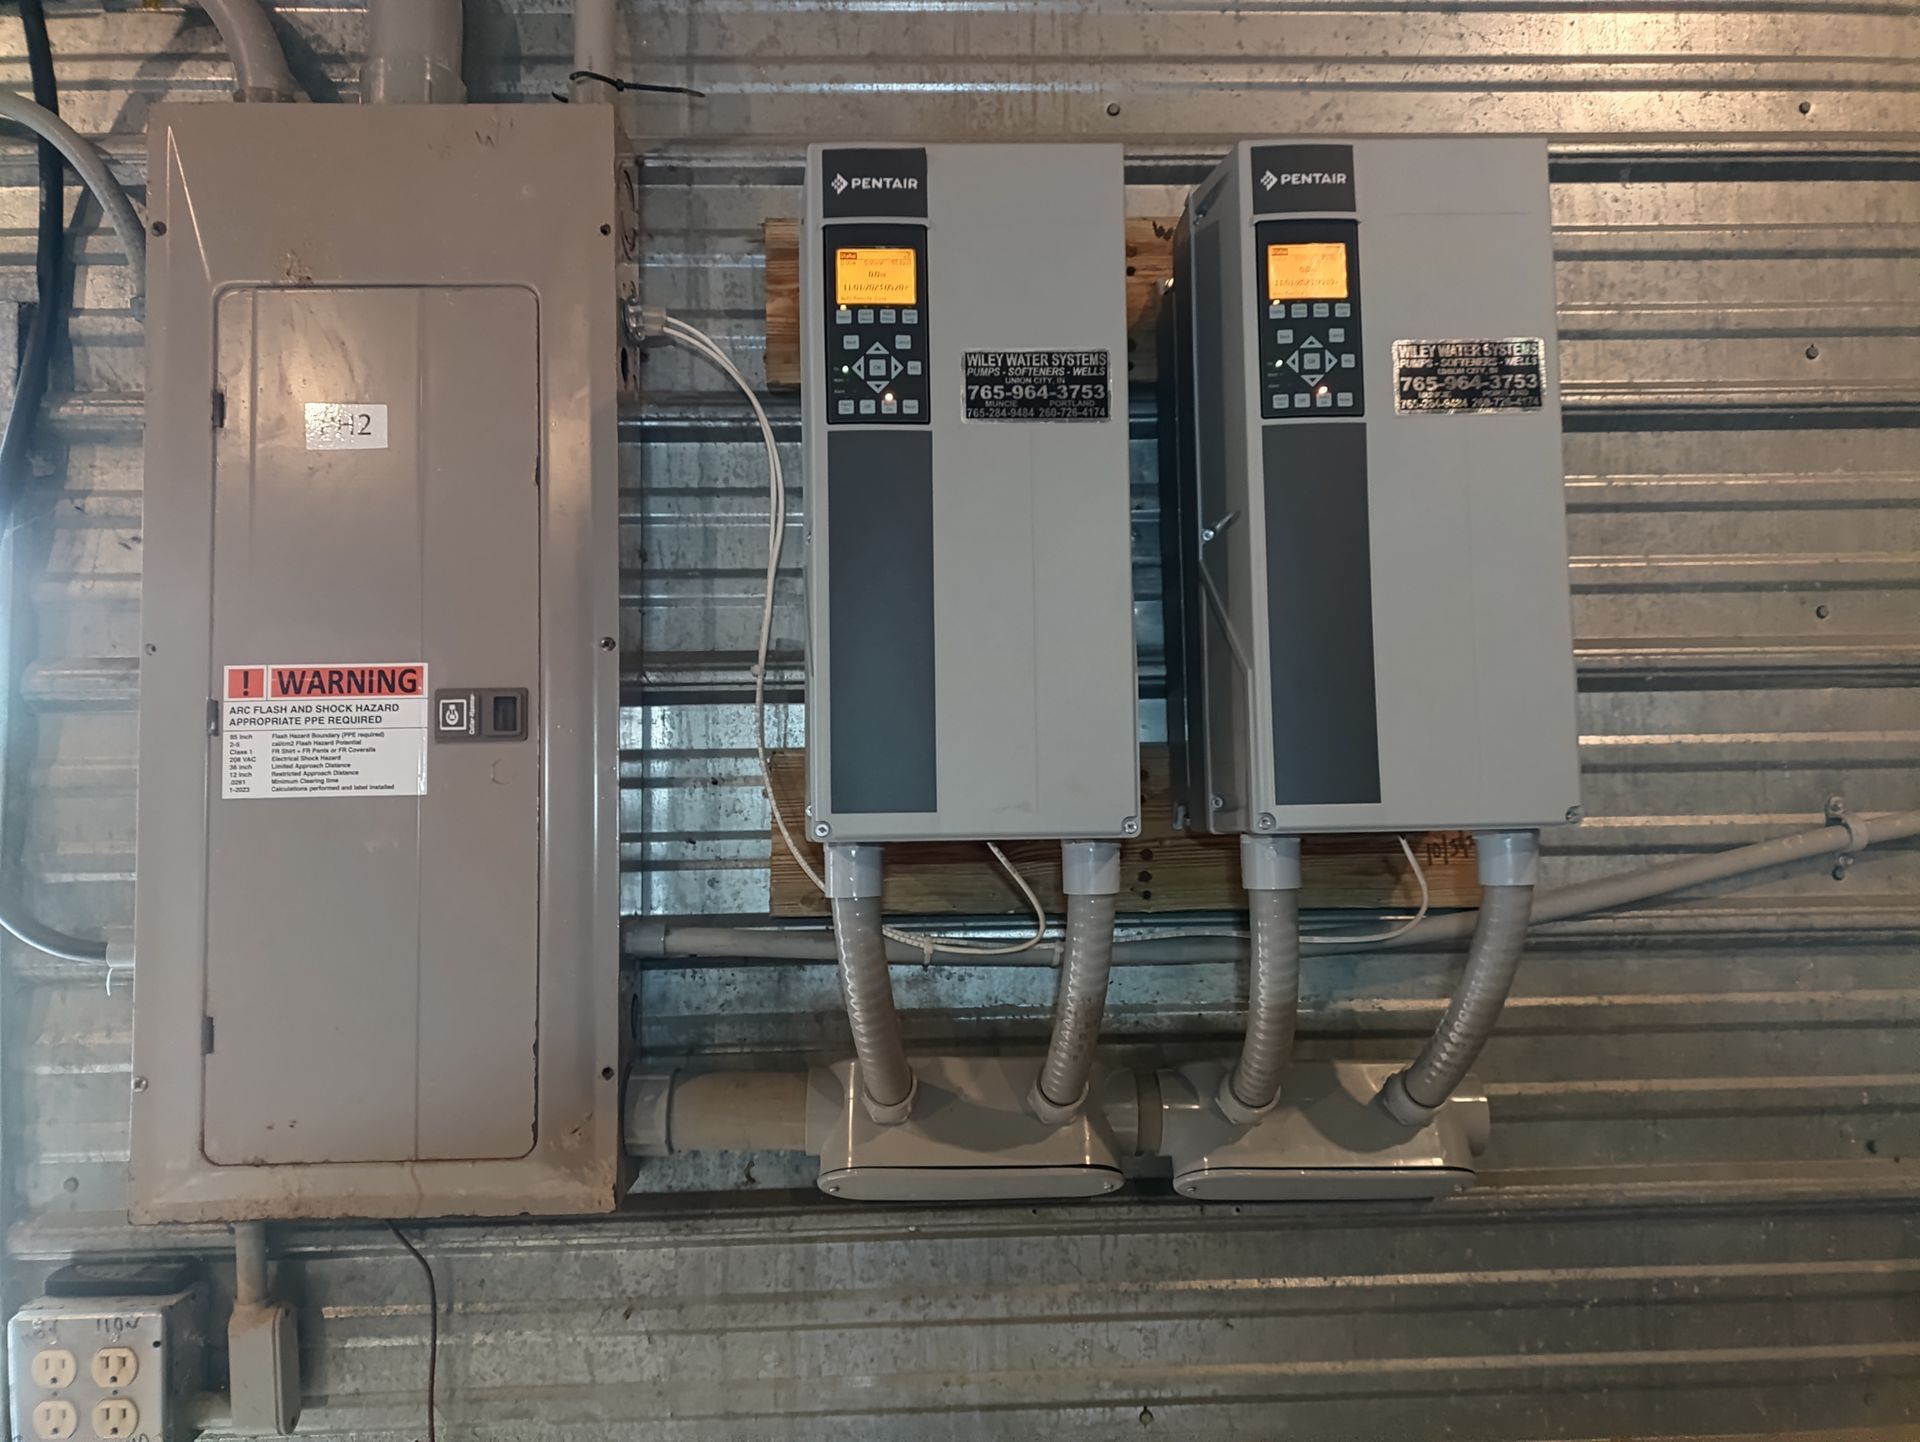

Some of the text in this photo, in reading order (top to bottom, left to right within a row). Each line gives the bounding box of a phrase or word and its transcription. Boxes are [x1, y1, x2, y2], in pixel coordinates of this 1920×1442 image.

[851, 177, 919, 190] PENTAIR
[1280, 173, 1347, 185] PENTAIR
[1399, 343, 1539, 358] WILEY WATER SYSTEMS
[966, 353, 1107, 367] WILEY WATER SYSTEMS
[966, 367, 1001, 377] PUMPS
[1007, 367, 1065, 377] SOFTENERS
[1072, 366, 1106, 377] WELLS
[1004, 377, 1032, 385] UNION
[1033, 377, 1055, 385] CITY,
[1400, 374, 1538, 392] 765-964-3753
[967, 384, 1106, 401] 765-964-3753
[985, 400, 1018, 408] MUNCIE
[967, 407, 1106, 418] 765-284-9484 260-726-4174
[277, 668, 418, 696] WARNING
[229, 703, 400, 715] ARC FLASH AND SHOCK HAZARD
[229, 715, 383, 727] APPROPRIATE PPE REQUIRED
[357, 731, 385, 739] required)
[308, 785, 340, 793] performed
